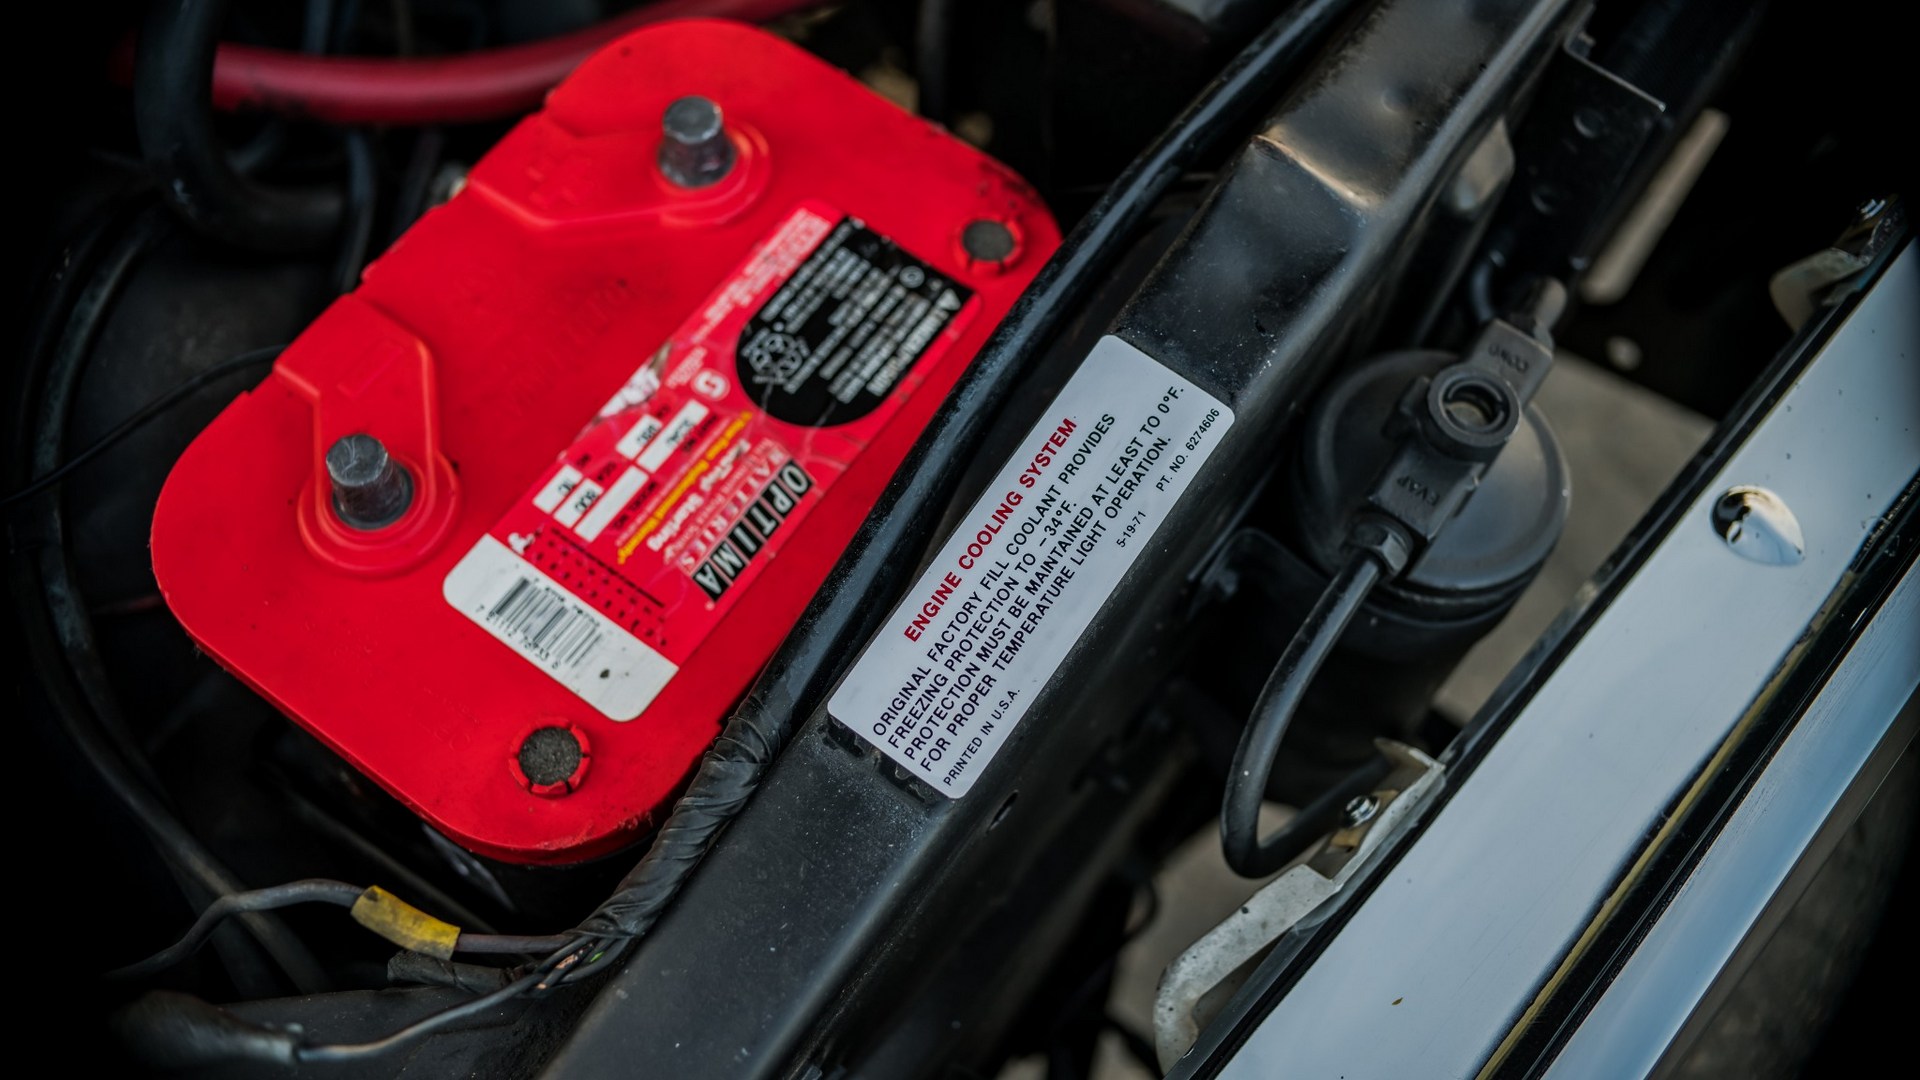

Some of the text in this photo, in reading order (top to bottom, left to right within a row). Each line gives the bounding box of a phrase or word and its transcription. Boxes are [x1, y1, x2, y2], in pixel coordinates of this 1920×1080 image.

[676, 446, 785, 572] BATTERIES
[693, 461, 811, 594] OPTIMA
[903, 417, 1077, 642] ENGINE COOLING SYSTEM
[1115, 407, 1219, 548] 5-19-71 PT. NO. 6274606
[1396, 474, 1441, 506] EVAP
[872, 413, 1115, 736] ORIGINAL FACTORY FILL COOLANT PROVIDES
[887, 673, 949, 749] FREEZING
[943, 575, 1019, 672] PROTECTION
[1013, 552, 1036, 573] TO
[903, 385, 1184, 760] PROTECTION MUST BE MAINTAINED AT LEAST TO 0°F.
[919, 436, 1171, 772] FOR PROPER TEMPERATURE LIGHT OPERATION.
[942, 690, 1018, 786] PRINTED IN U.S.A.
